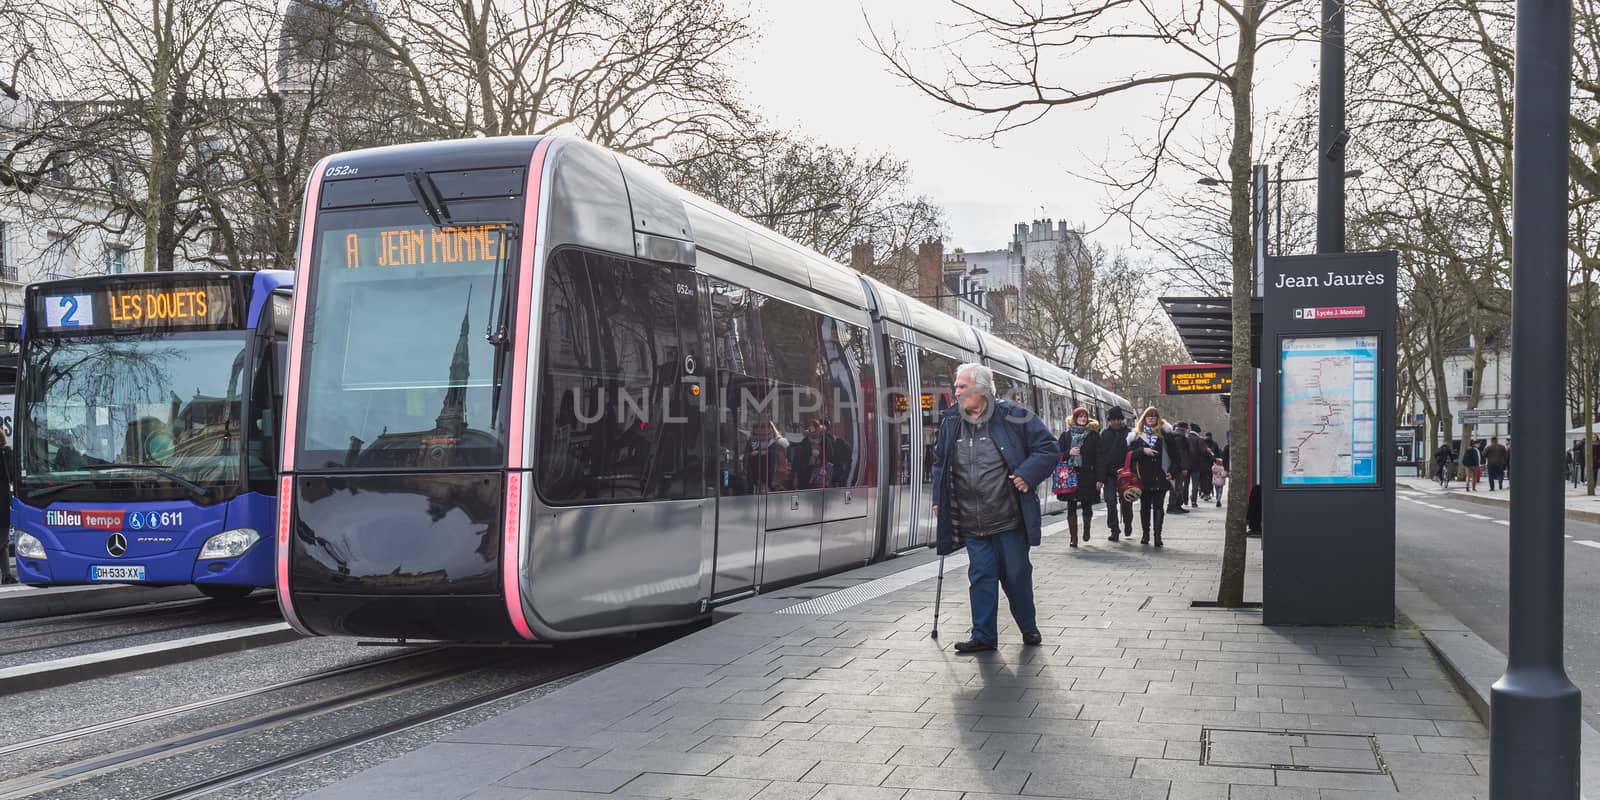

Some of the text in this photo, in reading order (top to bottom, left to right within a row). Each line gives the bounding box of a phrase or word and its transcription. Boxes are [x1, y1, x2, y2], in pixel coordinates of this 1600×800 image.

[346, 223, 507, 269] A JEAN MONNET
[1275, 270, 1385, 288] Jean Jaurès
[59, 296, 79, 326] 2
[111, 291, 207, 321] LES DOUETS
[46, 510, 81, 526] filbleu
[86, 514, 121, 529] tempo
[161, 511, 183, 526] 611
